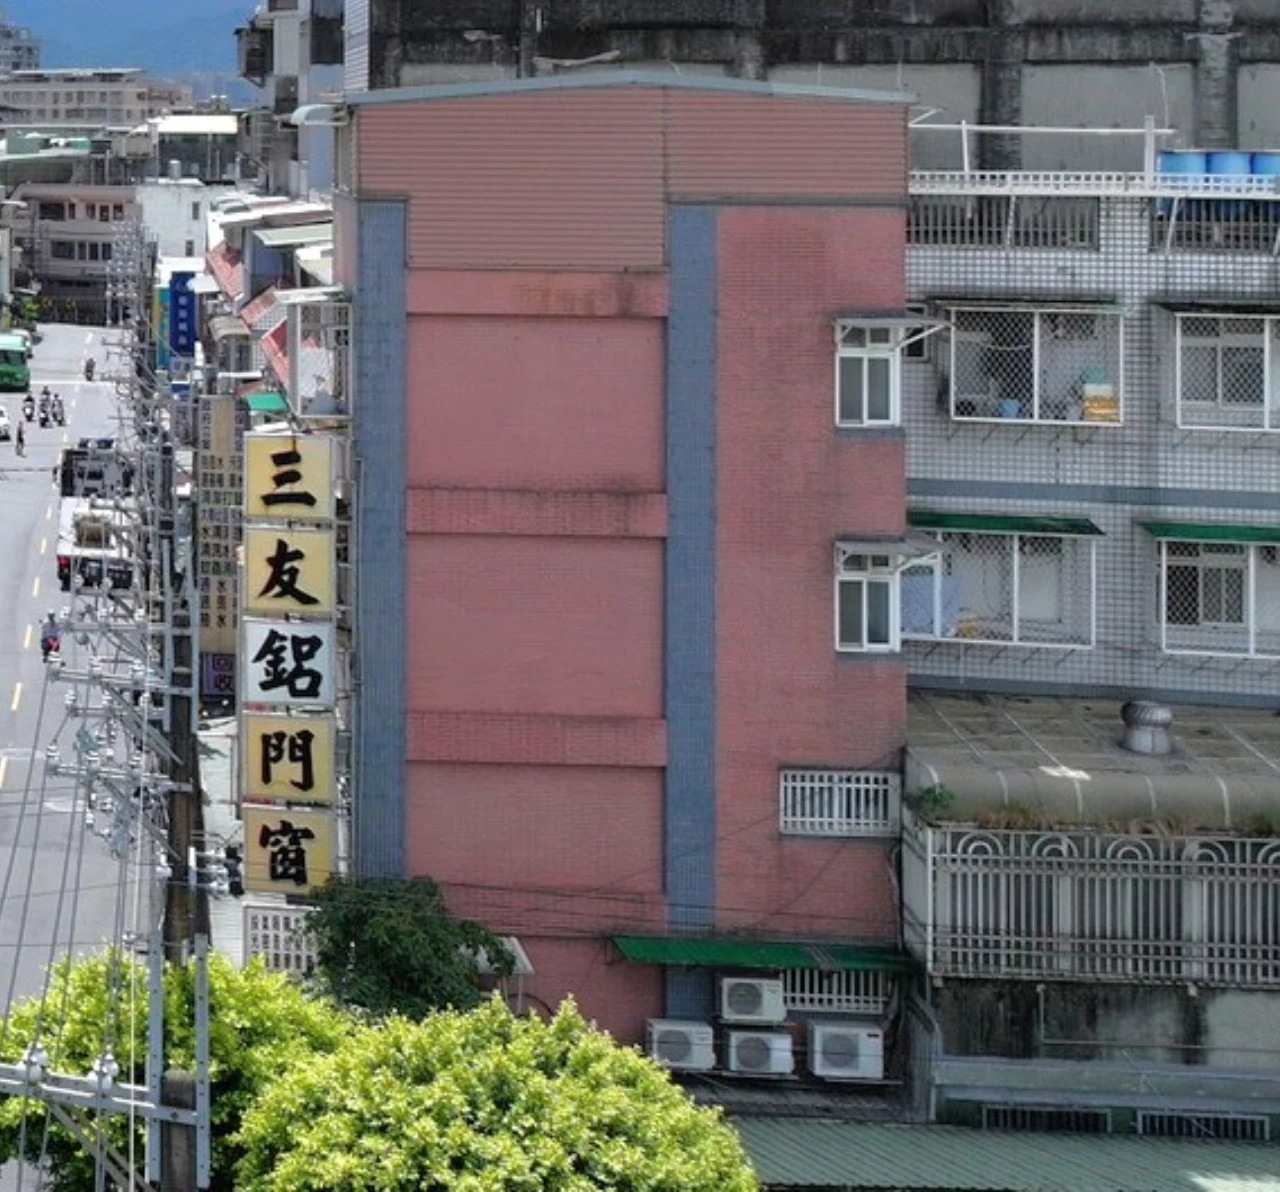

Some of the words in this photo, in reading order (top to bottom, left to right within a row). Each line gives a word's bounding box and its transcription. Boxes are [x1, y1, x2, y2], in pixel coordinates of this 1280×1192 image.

[252, 450, 325, 887] 三友鋁門窗
